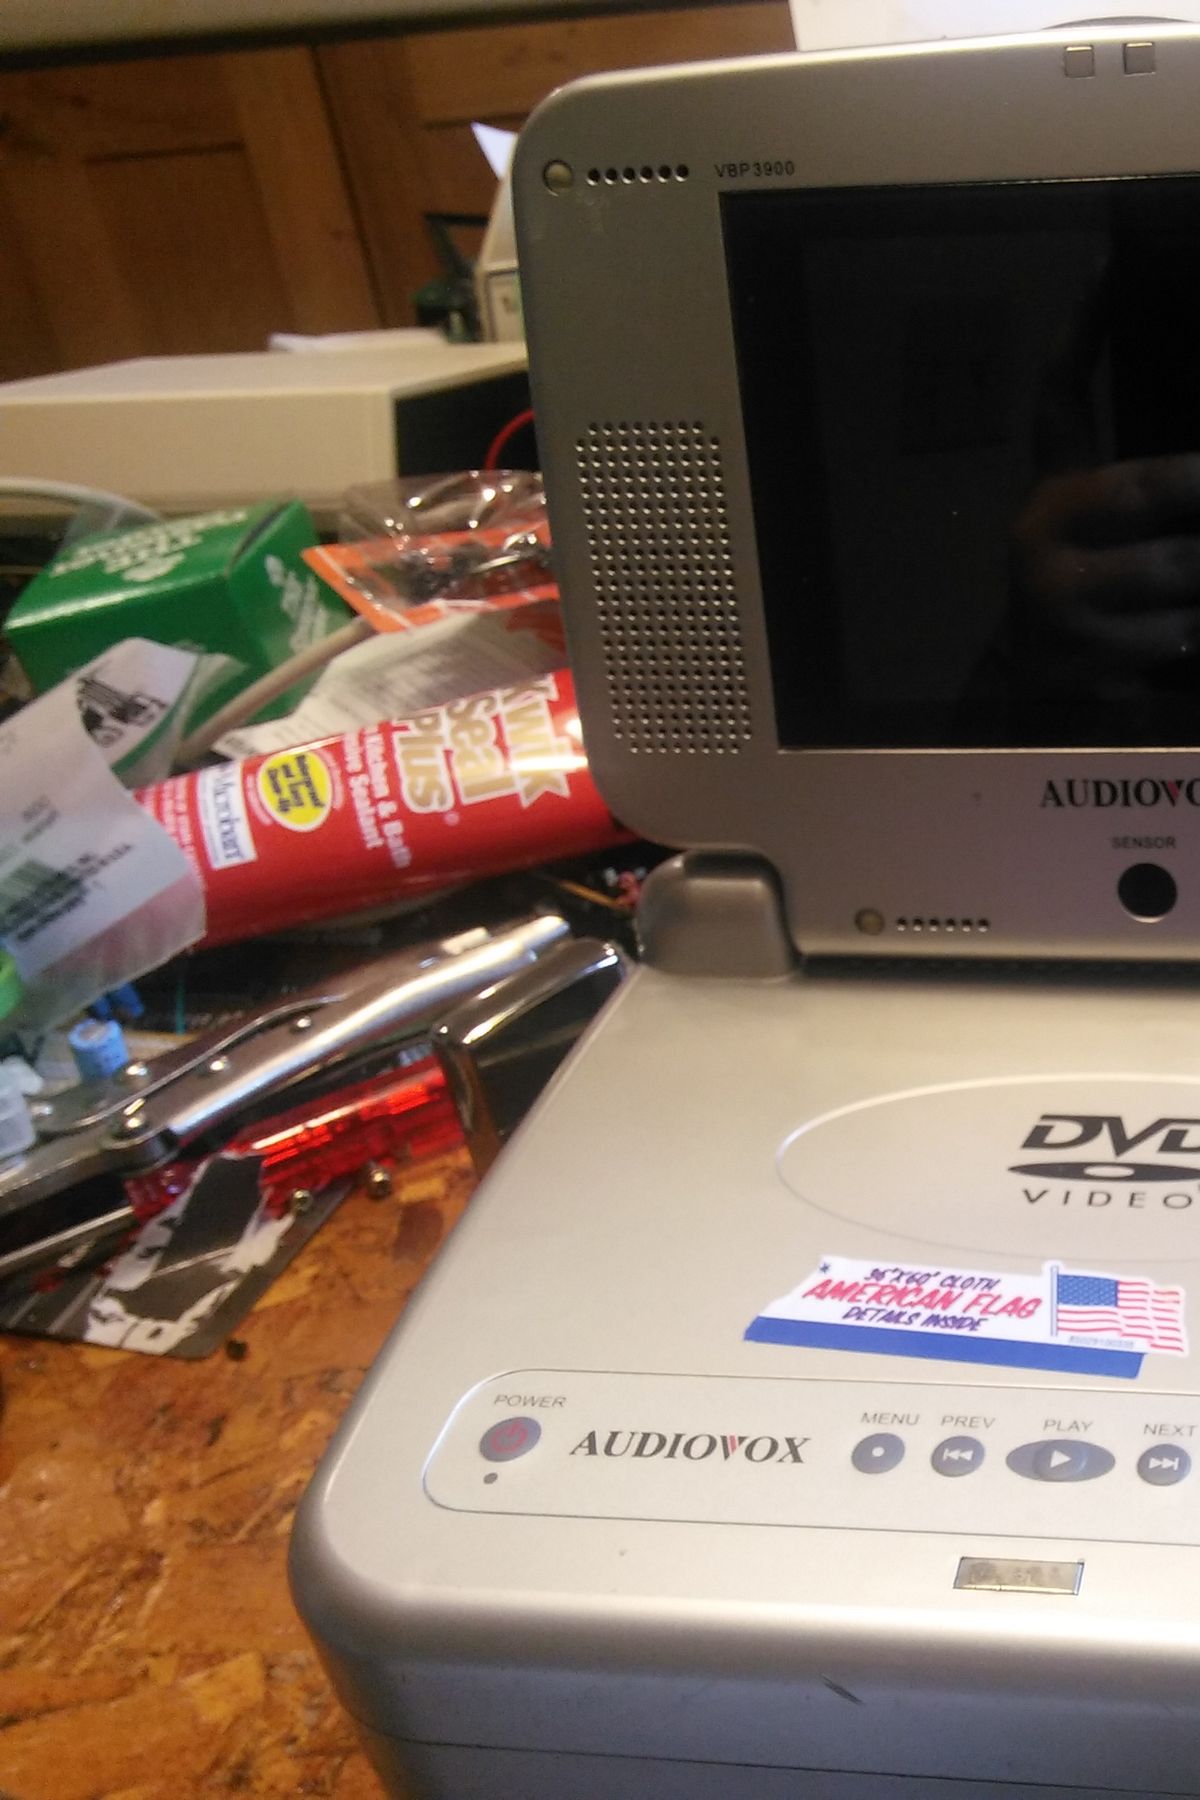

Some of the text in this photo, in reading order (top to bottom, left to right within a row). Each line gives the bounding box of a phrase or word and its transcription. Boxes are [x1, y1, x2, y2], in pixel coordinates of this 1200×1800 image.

[714, 161, 796, 177] VBP3900
[500, 672, 572, 809] Kwik
[447, 692, 517, 806] Seal
[391, 707, 455, 814] Plus
[1111, 836, 1177, 849] SENSOR
[1022, 1189, 1194, 1210] VIDEO
[939, 1275, 1001, 1291] CLOTH
[802, 1278, 1043, 1319] AMERICAN FLAG
[842, 1306, 989, 1332] DETAILS INSIDE
[493, 1394, 568, 1409] POWER
[860, 1411, 921, 1427] MENU
[940, 1415, 996, 1430] PREV
[1043, 1418, 1095, 1433] PLAY
[1143, 1423, 1198, 1438] NEXT
[569, 1429, 812, 1464] AUDIOVOX
